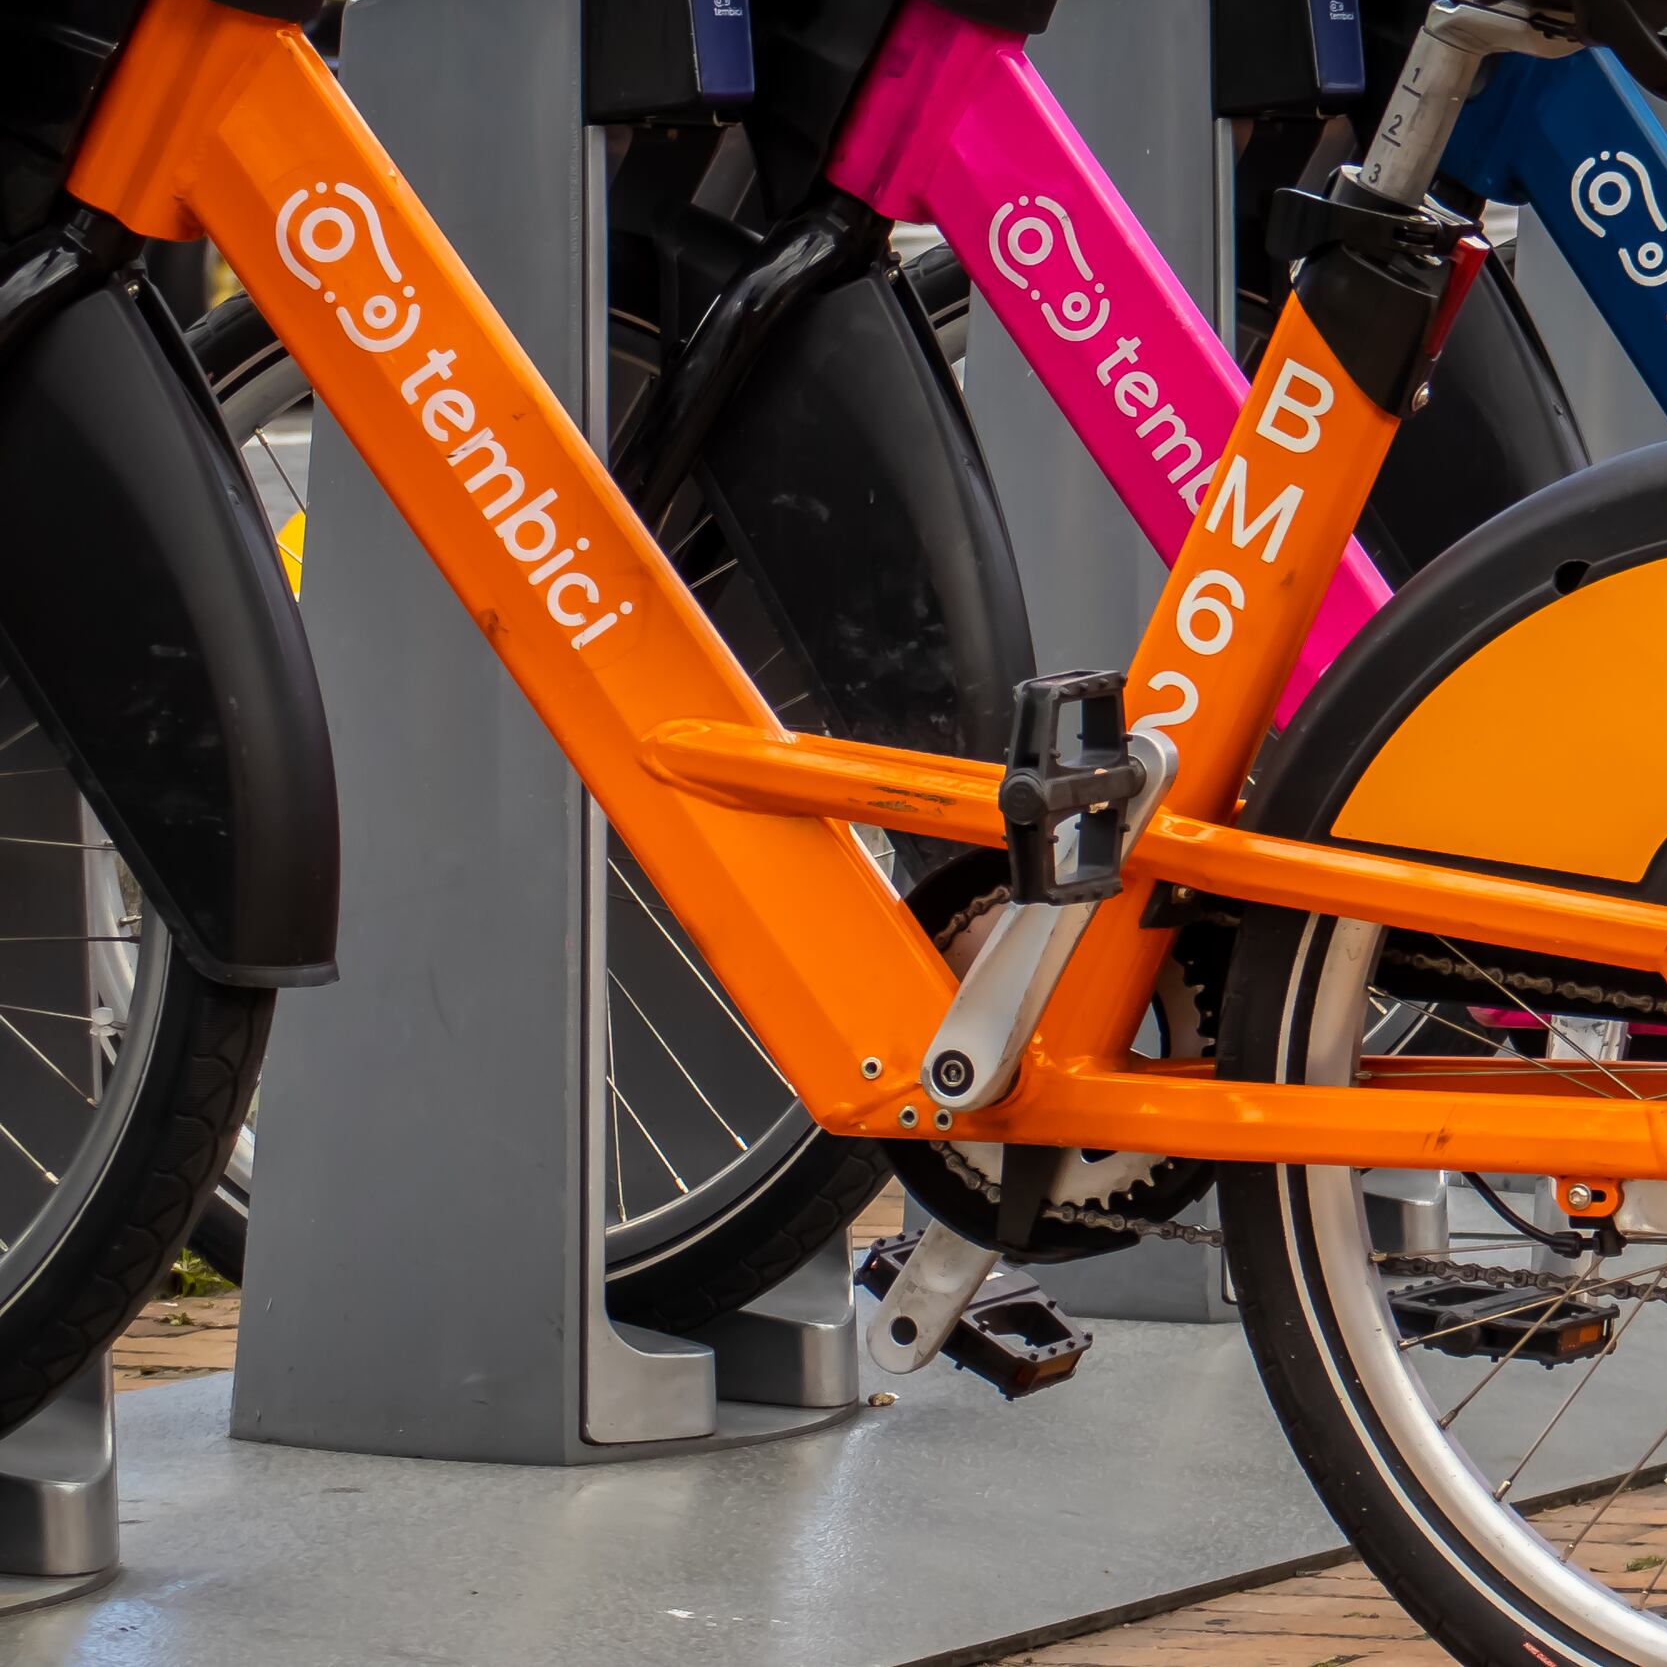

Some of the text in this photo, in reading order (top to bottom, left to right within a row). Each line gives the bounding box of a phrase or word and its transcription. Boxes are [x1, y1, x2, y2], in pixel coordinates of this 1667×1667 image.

[1388, 114, 1402, 136] 2
[1368, 163, 1382, 184] 3
[400, 349, 633, 651] tembici
